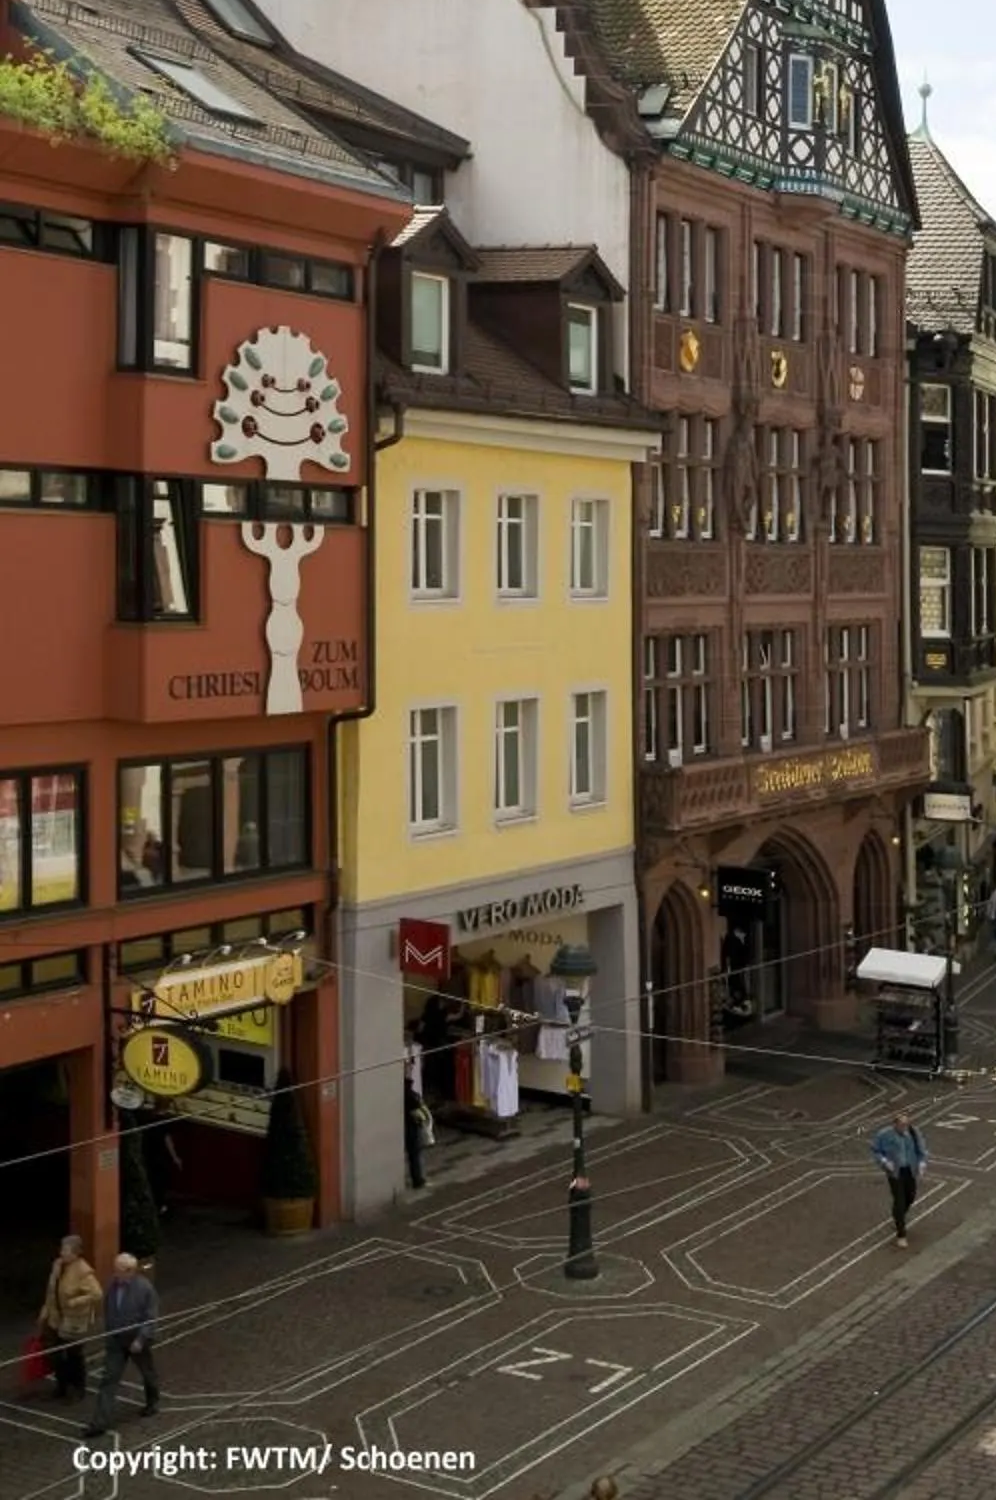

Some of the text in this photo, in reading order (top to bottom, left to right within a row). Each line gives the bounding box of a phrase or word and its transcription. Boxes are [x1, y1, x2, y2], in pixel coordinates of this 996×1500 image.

[312, 640, 358, 663] ZUM
[722, 884, 763, 897] GEOX
[457, 884, 585, 932] VERO MODA
[509, 928, 564, 945] MODA
[166, 971, 244, 1000] TAMINO
[136, 1064, 188, 1085] TAMINO
